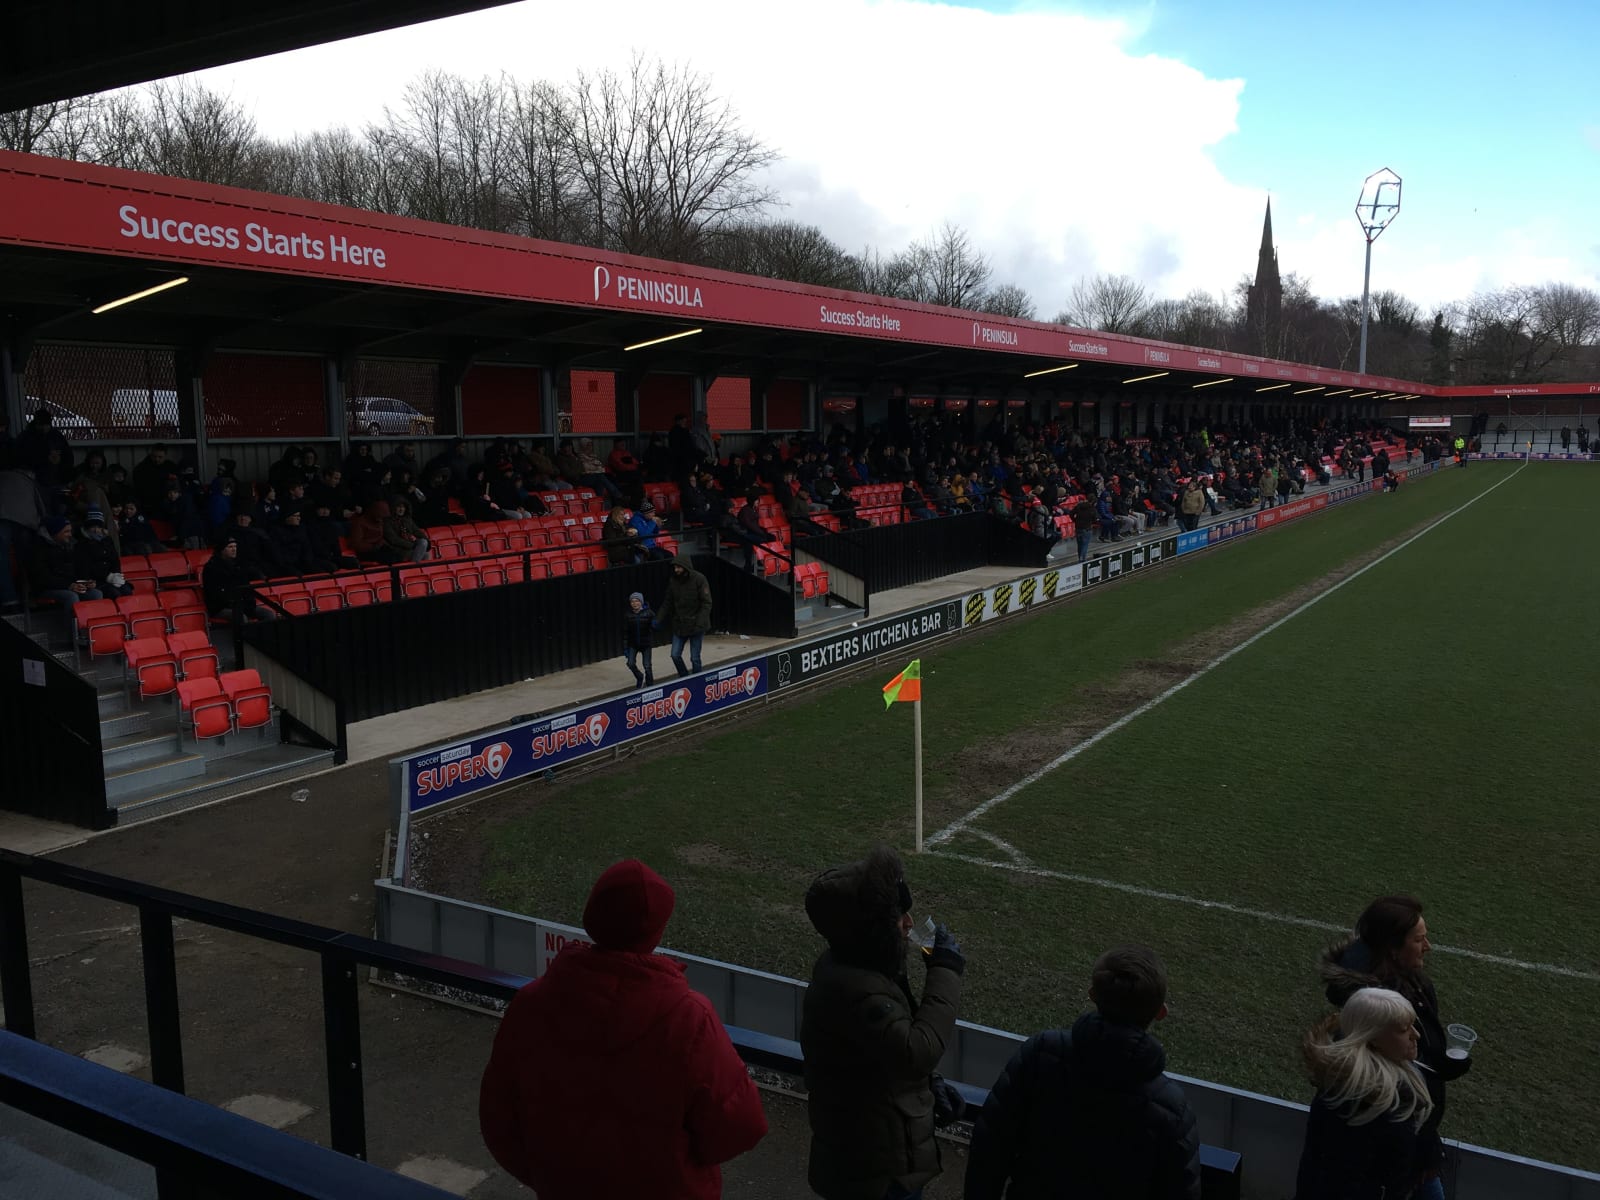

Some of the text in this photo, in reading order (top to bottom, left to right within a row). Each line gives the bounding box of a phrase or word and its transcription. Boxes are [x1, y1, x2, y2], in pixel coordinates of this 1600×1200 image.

[119, 205, 386, 268] Success Starts Here
[617, 276, 704, 308] PENINSULA
[820, 306, 901, 332] Success Starts Here
[982, 327, 1018, 346] PENINSULA
[801, 612, 941, 673] BEXTERS KITCHEN & BAR
[532, 724, 551, 734] soccer
[417, 747, 471, 768] soccer saturday
